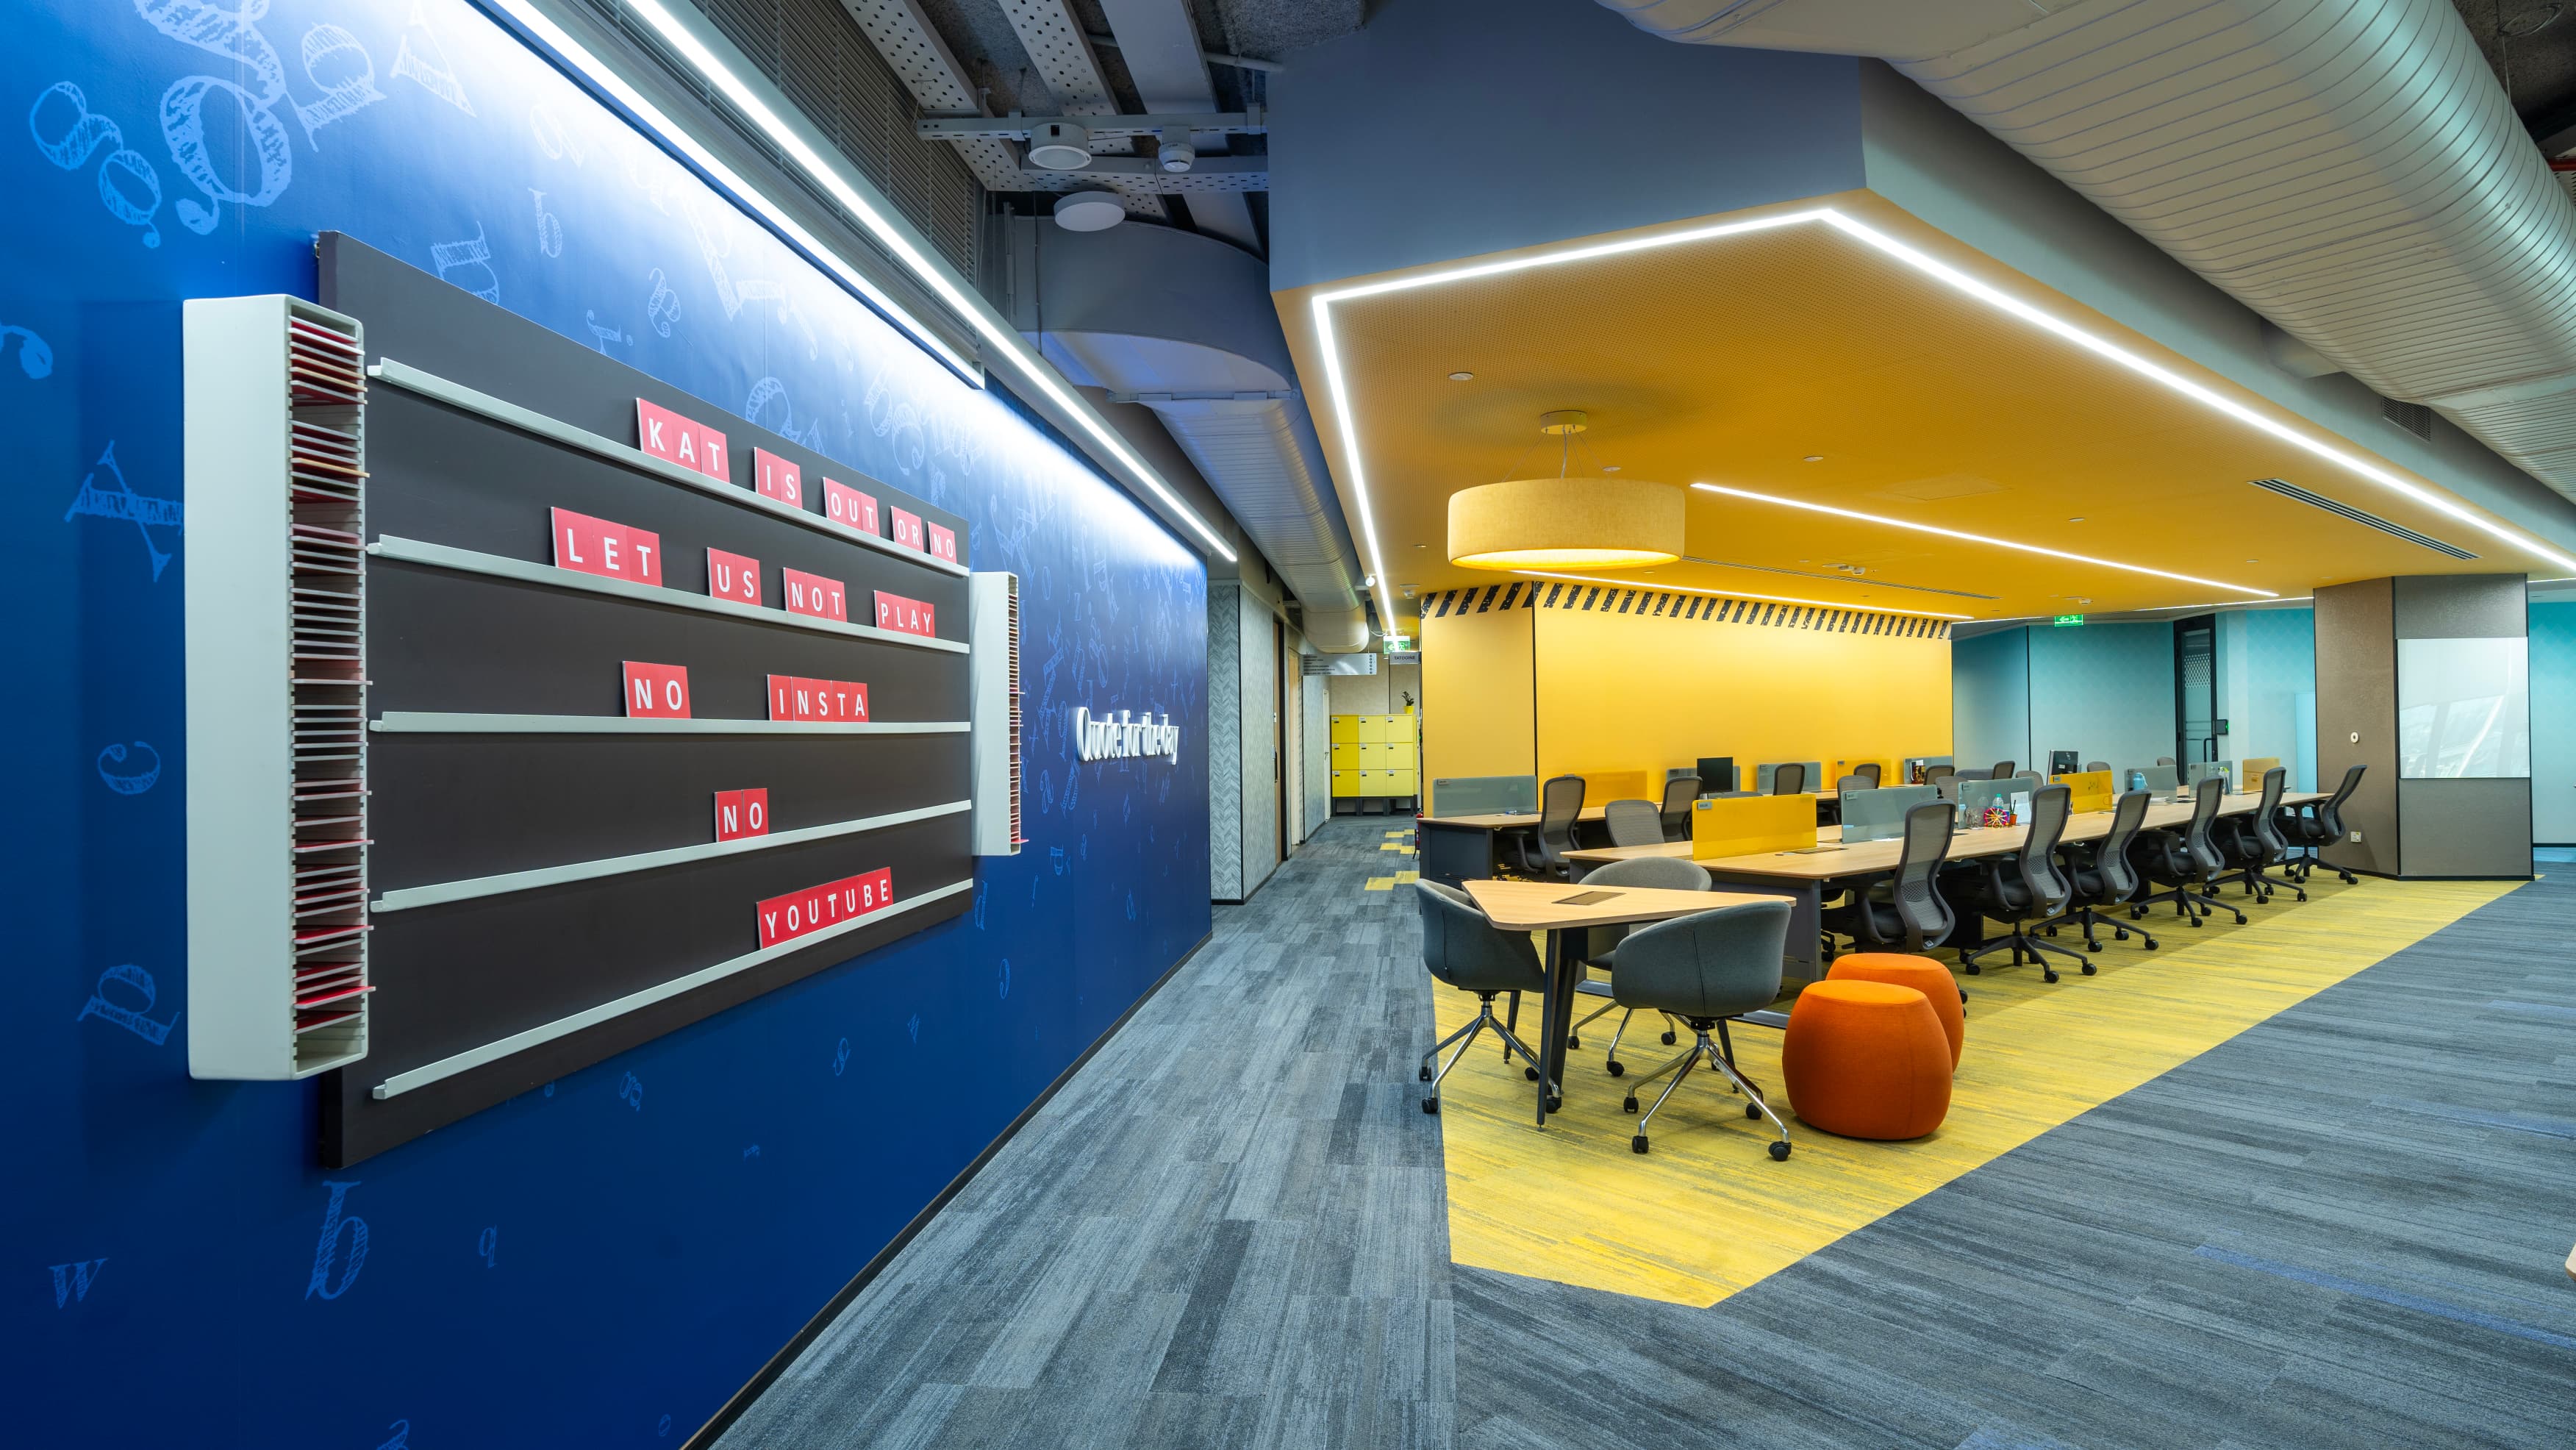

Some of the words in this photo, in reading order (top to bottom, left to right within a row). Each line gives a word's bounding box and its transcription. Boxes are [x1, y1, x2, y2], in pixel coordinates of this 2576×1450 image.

[648, 417, 721, 472] KAT
[765, 464, 798, 501] IS
[831, 490, 875, 529] OUT
[897, 518, 920, 546] OR
[933, 534, 954, 559] NO
[567, 528, 652, 576] LET
[717, 563, 754, 599] US
[791, 582, 841, 615] NOT
[881, 602, 931, 633] PLAY
[634, 678, 682, 710] NO
[779, 688, 865, 716] INSTA
[723, 802, 763, 833] NO
[765, 879, 889, 938] YOUTUBE
